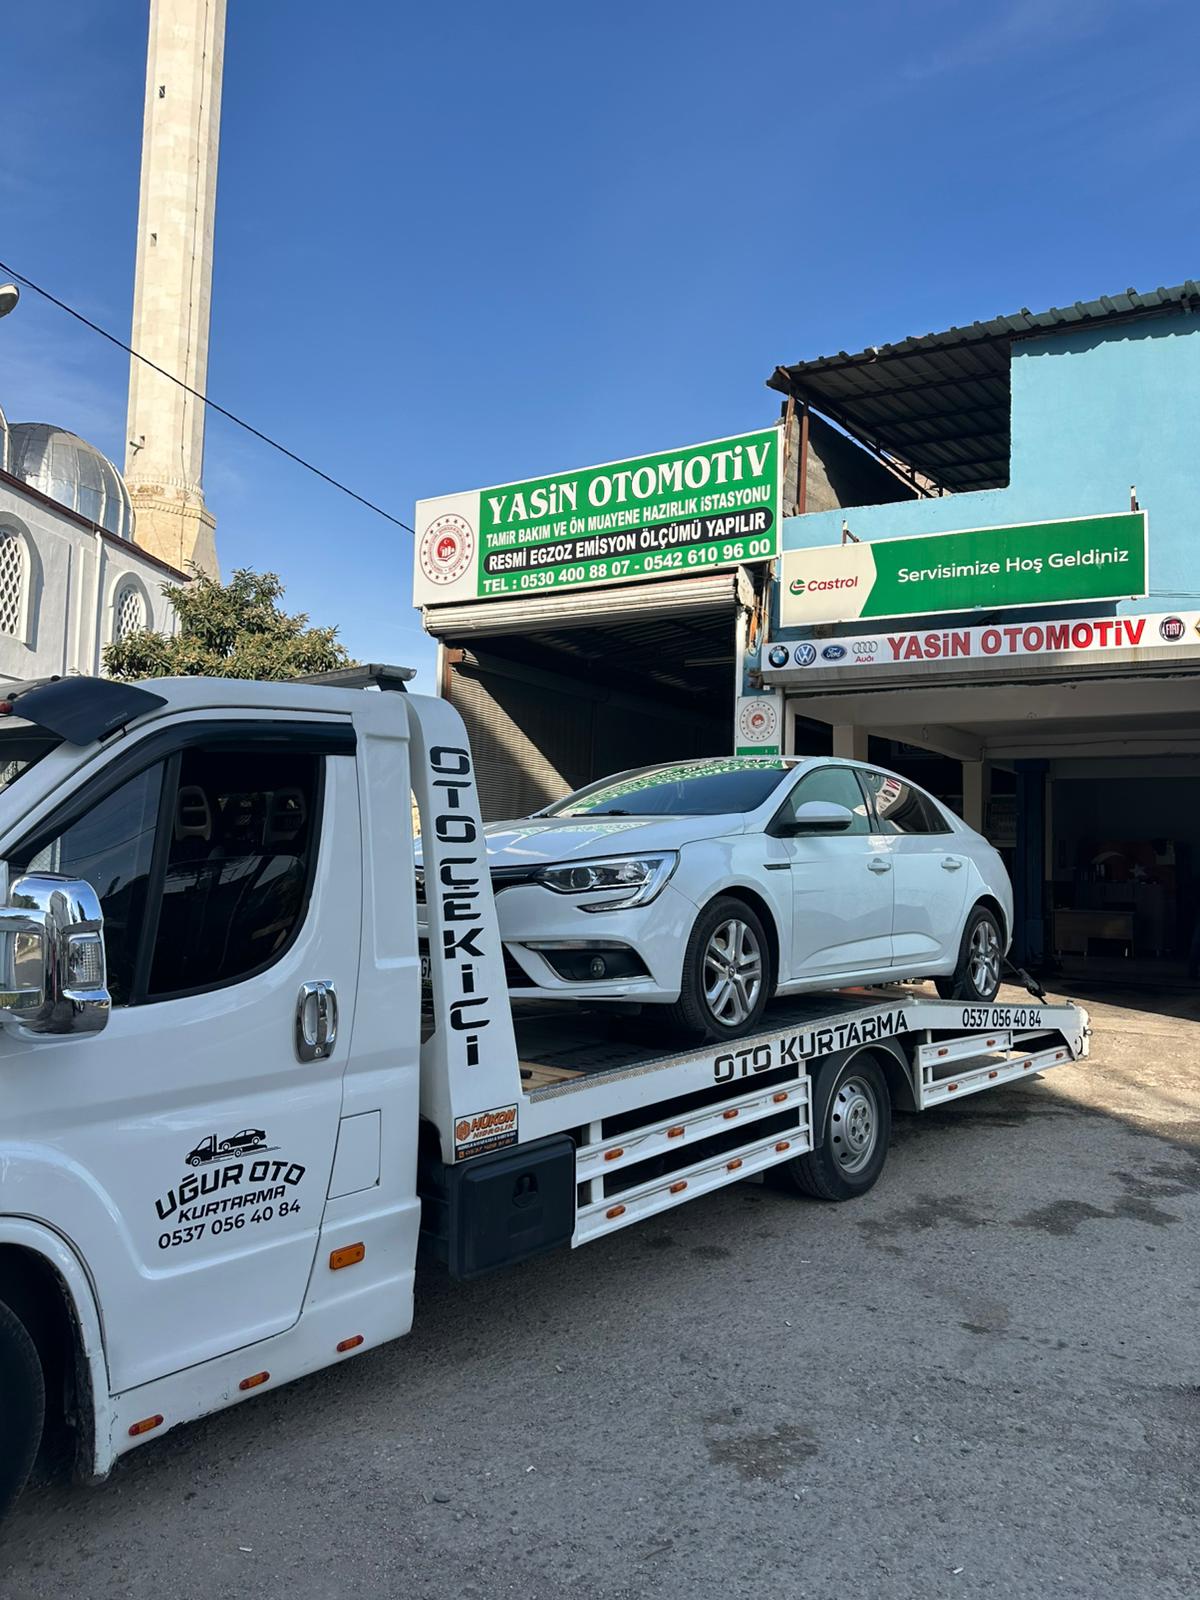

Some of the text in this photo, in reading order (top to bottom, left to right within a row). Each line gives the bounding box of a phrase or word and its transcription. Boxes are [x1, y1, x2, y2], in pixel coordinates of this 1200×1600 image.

[489, 547, 527, 571] RESMİ
[530, 543, 573, 565] EGZOZ
[576, 533, 636, 558] EMİSYON
[640, 519, 701, 549] ÖLÇÜMÜ
[705, 512, 766, 537] YAPILIR
[518, 524, 551, 543] BAKIM
[553, 521, 567, 537] VE
[569, 517, 585, 534] ÖN
[588, 508, 640, 532] MUAYENE
[643, 498, 698, 522] HAZIRLIK
[483, 578, 509, 593] TEL
[520, 571, 554, 588] 0530
[558, 566, 585, 583] 400
[589, 563, 607, 579] 88
[611, 560, 630, 575] 07
[643, 551, 683, 571] 0542
[687, 546, 718, 564] 610
[723, 543, 744, 560] 96
[749, 538, 770, 556] 00
[807, 576, 858, 592] Castrol
[898, 547, 1129, 583] Servisimize Hoş Geldiniz
[962, 1008, 1041, 1027] 0537 056 40 84
[714, 1010, 908, 1084] OTO KURTARMA
[471, 1108, 516, 1132] HÜKON
[155, 1161, 305, 1220] UĞUR OTO
[178, 1185, 286, 1223] KURTARMA
[158, 1199, 301, 1249] 0537 056 40 84
